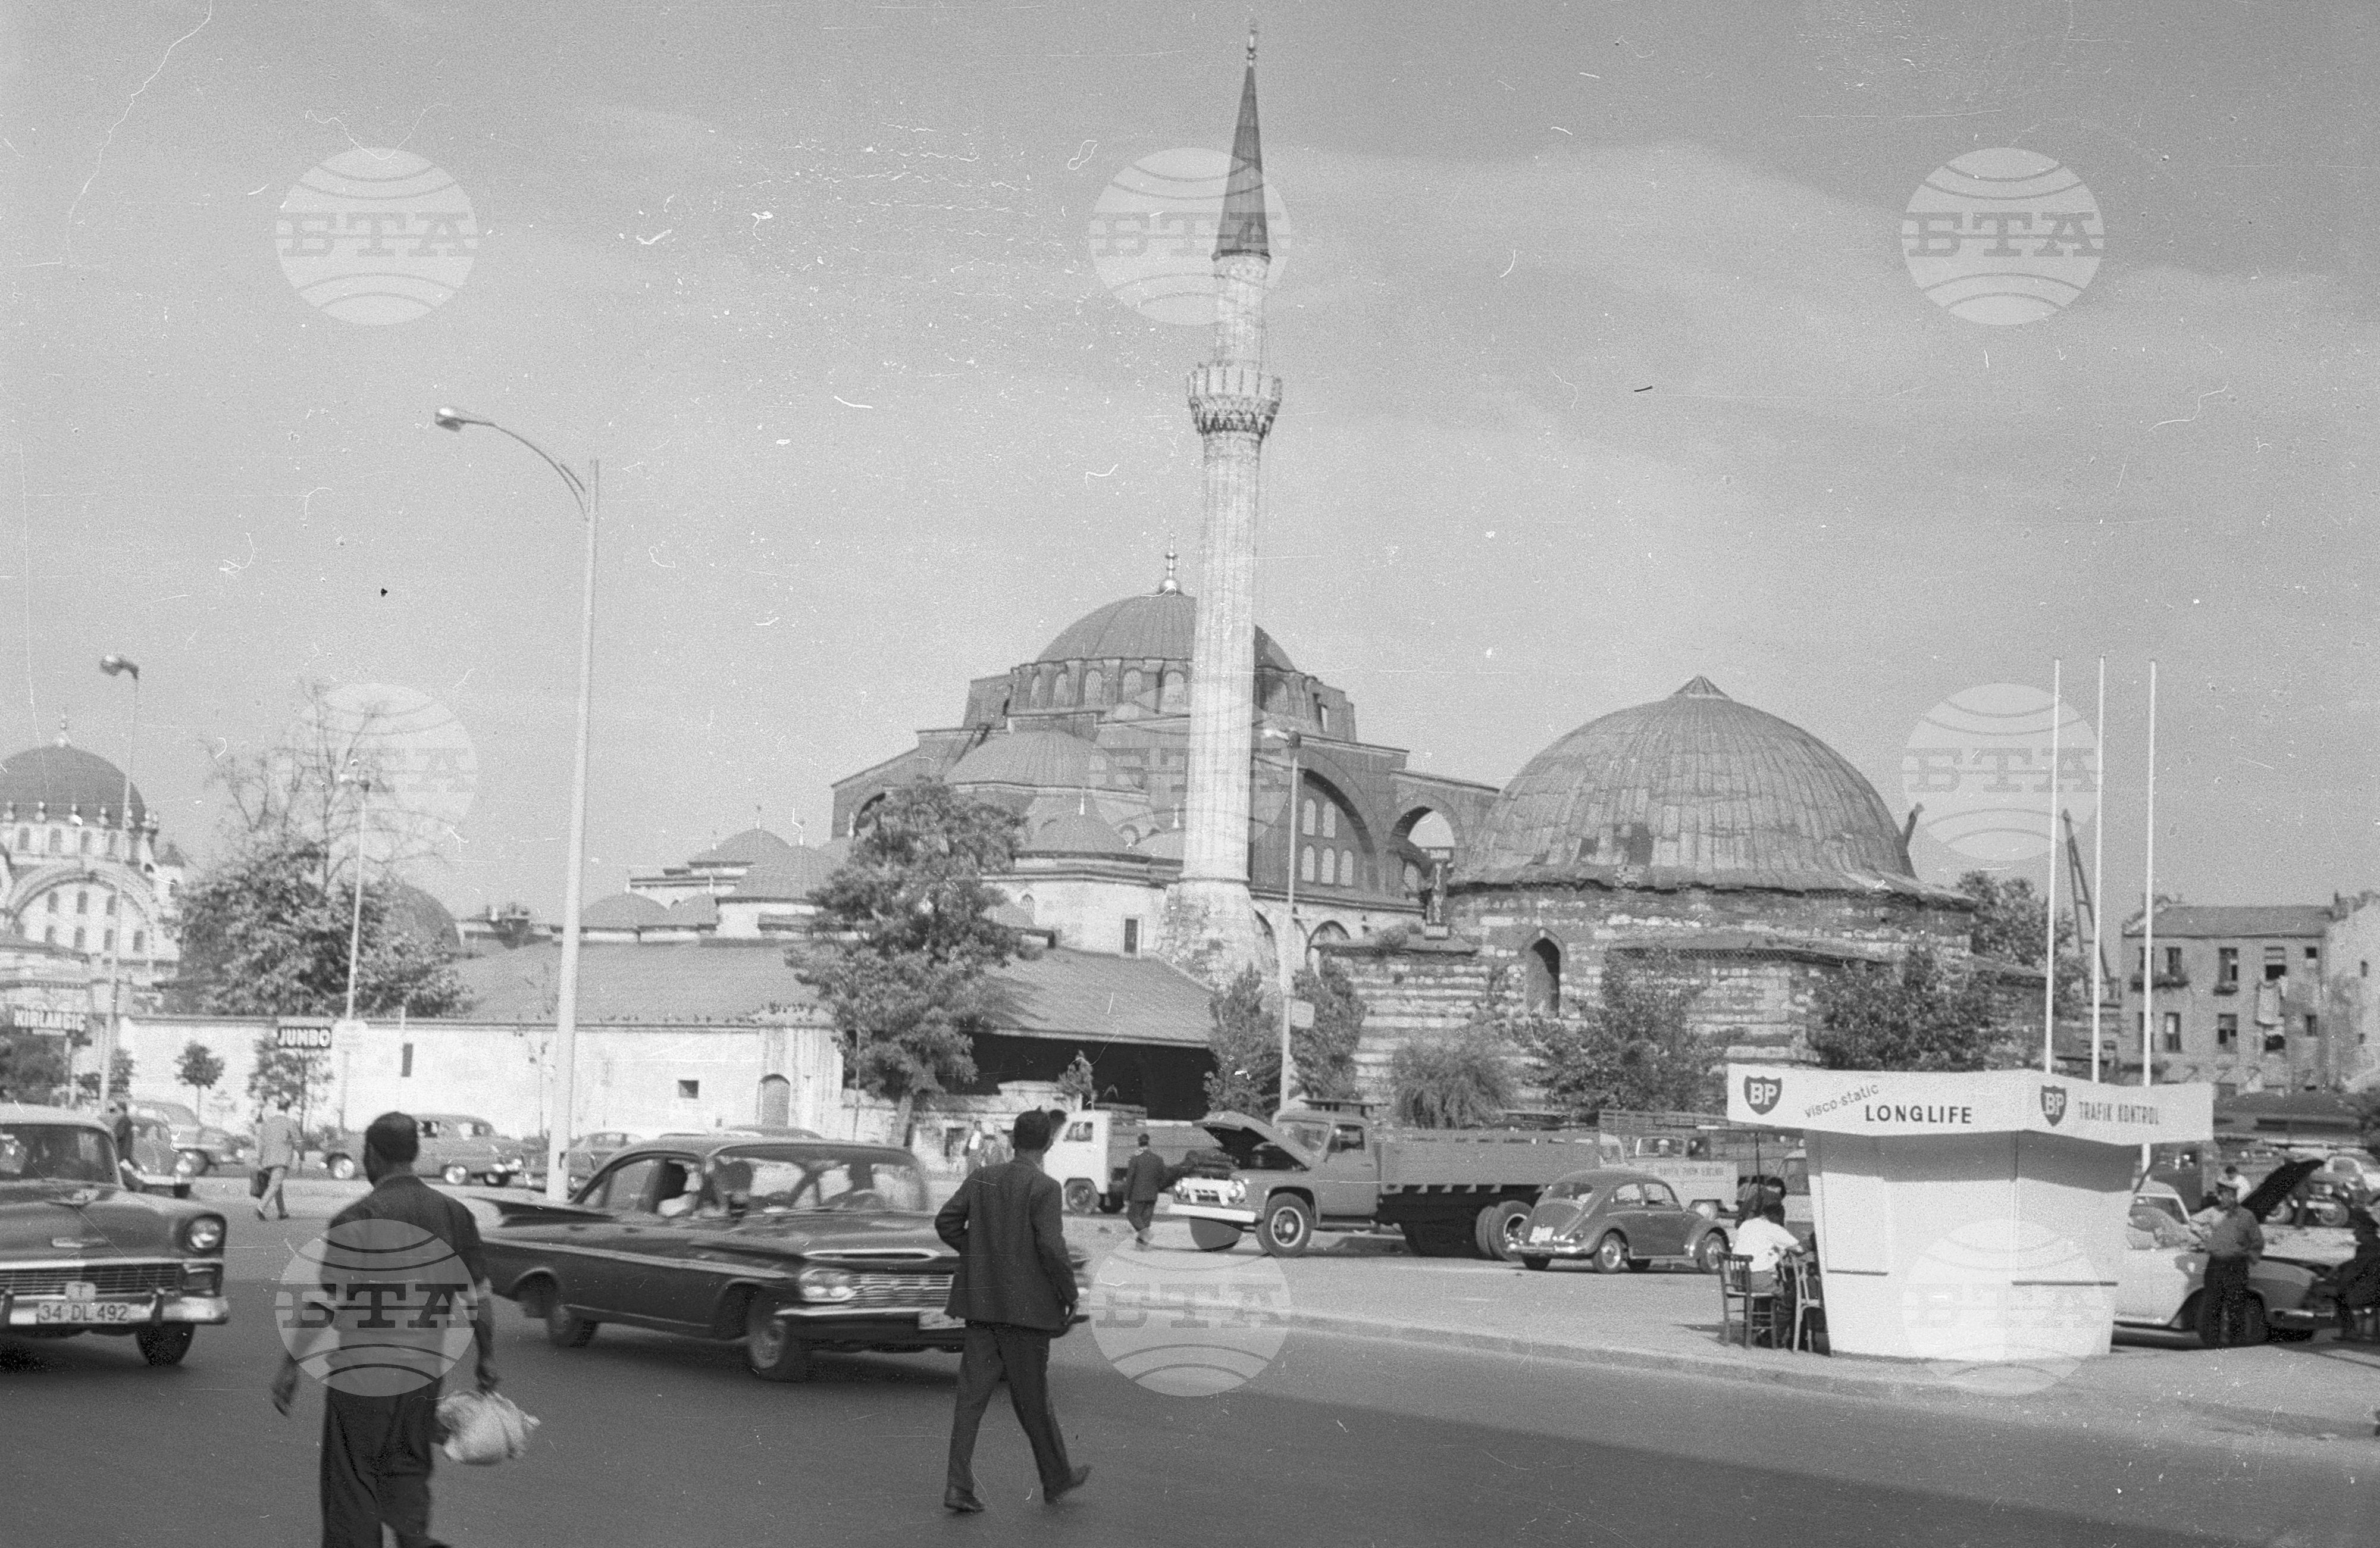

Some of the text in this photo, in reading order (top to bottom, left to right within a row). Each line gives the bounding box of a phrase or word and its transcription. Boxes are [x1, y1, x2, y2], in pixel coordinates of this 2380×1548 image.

[277, 1028, 332, 1047] JUMBO
[1749, 1082, 1777, 1106] BP
[2044, 1092, 2065, 1116] BP
[1865, 1104, 1972, 1124] LONGLIFE
[2118, 1103, 2159, 1125] KONTROL
[39, 1304, 128, 1321] 34 DL 492
